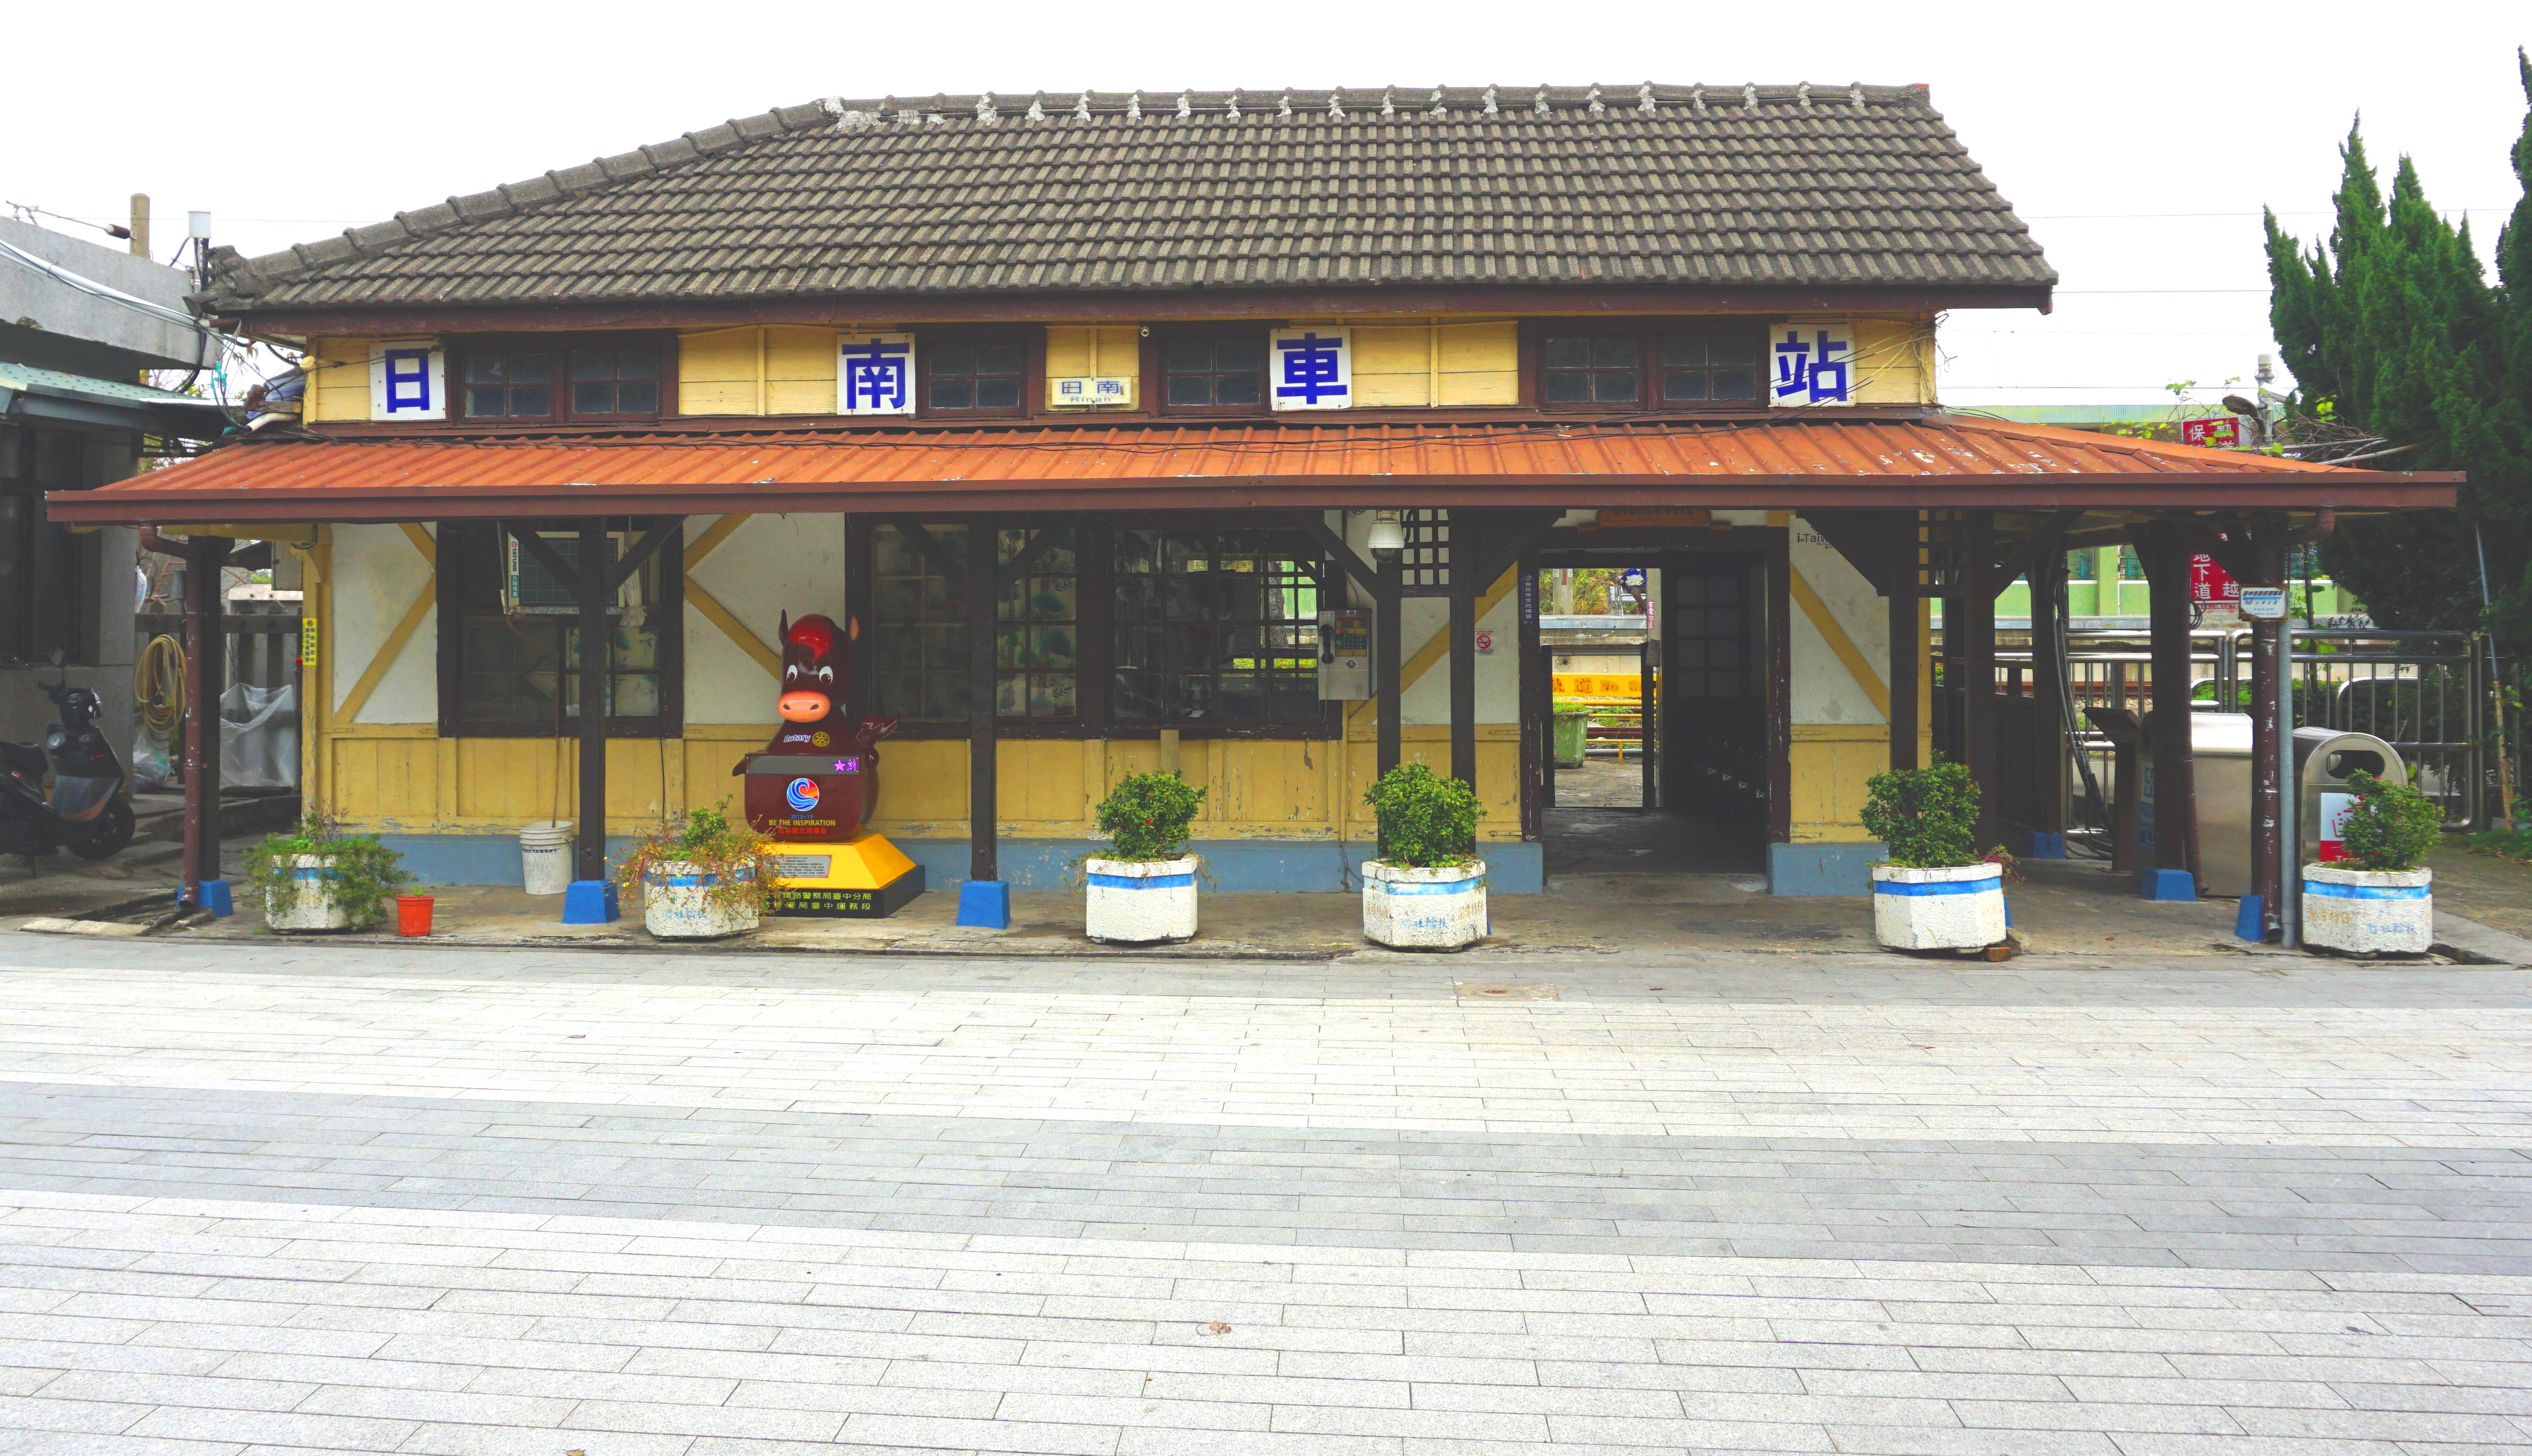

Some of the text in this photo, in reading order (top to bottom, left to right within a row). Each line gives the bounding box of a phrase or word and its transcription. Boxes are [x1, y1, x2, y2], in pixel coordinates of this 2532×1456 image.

[385, 331, 1847, 413] 日 南 車 站
[1062, 380, 1119, 394] 日南
[783, 734, 812, 743] Rotary
